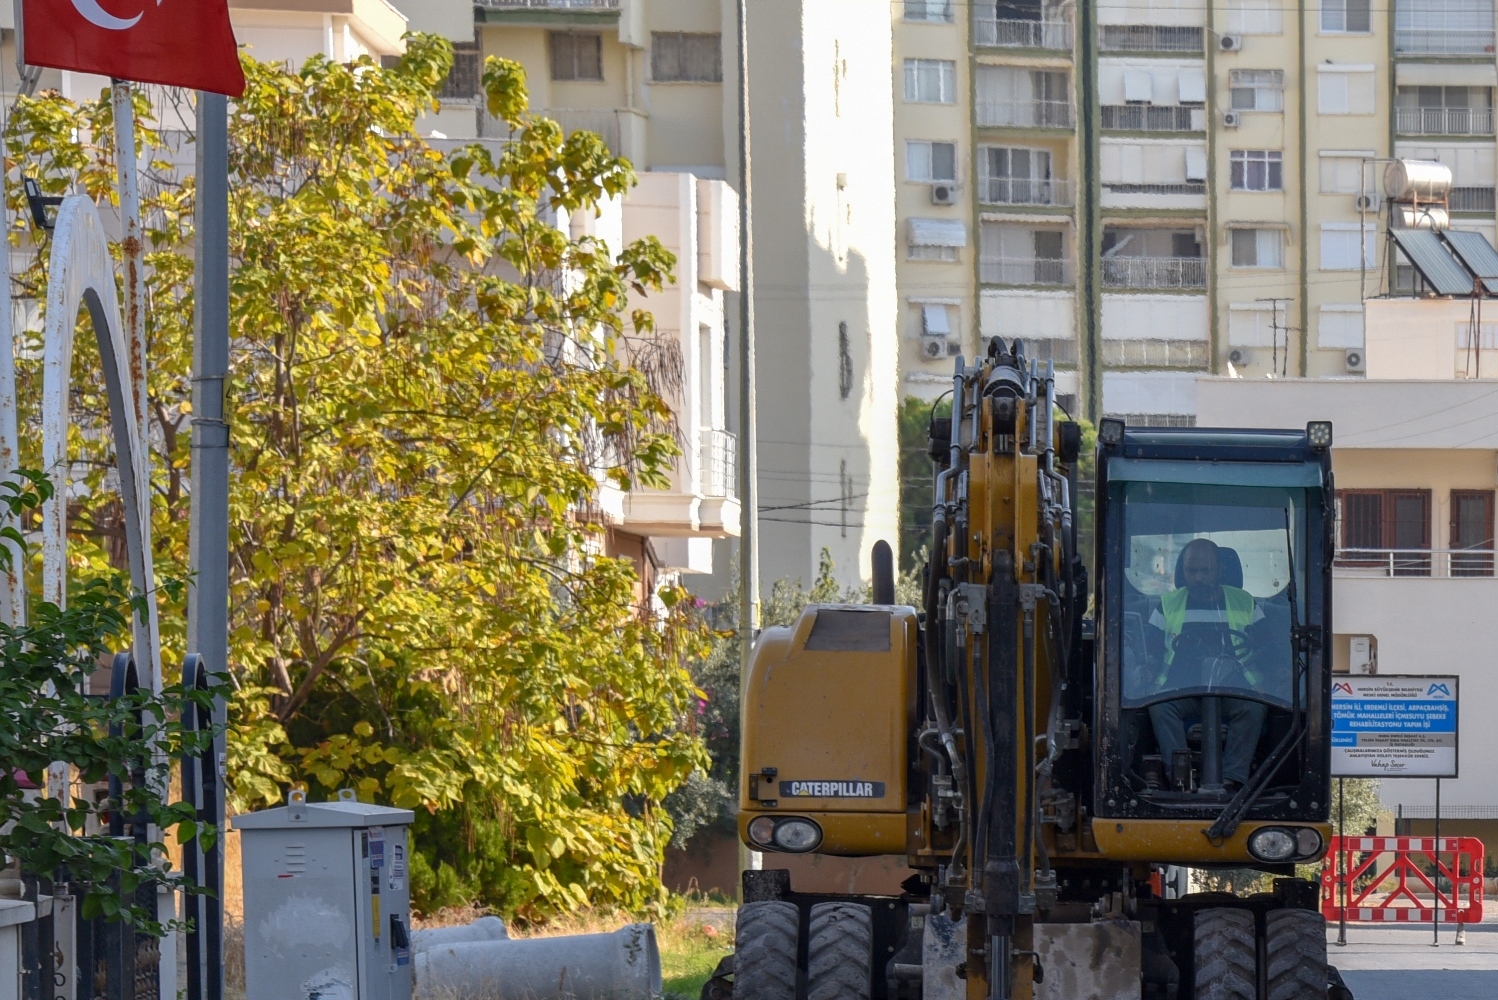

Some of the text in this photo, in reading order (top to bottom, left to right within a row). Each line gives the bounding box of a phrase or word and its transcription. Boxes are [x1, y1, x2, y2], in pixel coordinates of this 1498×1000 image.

[1331, 702, 1353, 710] MERSİN
[1333, 711, 1355, 719] TÖMÜK
[1356, 711, 1395, 719] MAHALLELERİ
[1395, 711, 1425, 720] İÇMESUYU
[1349, 719, 1402, 728] REHABİLİTASYONU
[791, 781, 873, 797] CATERPILLAR
